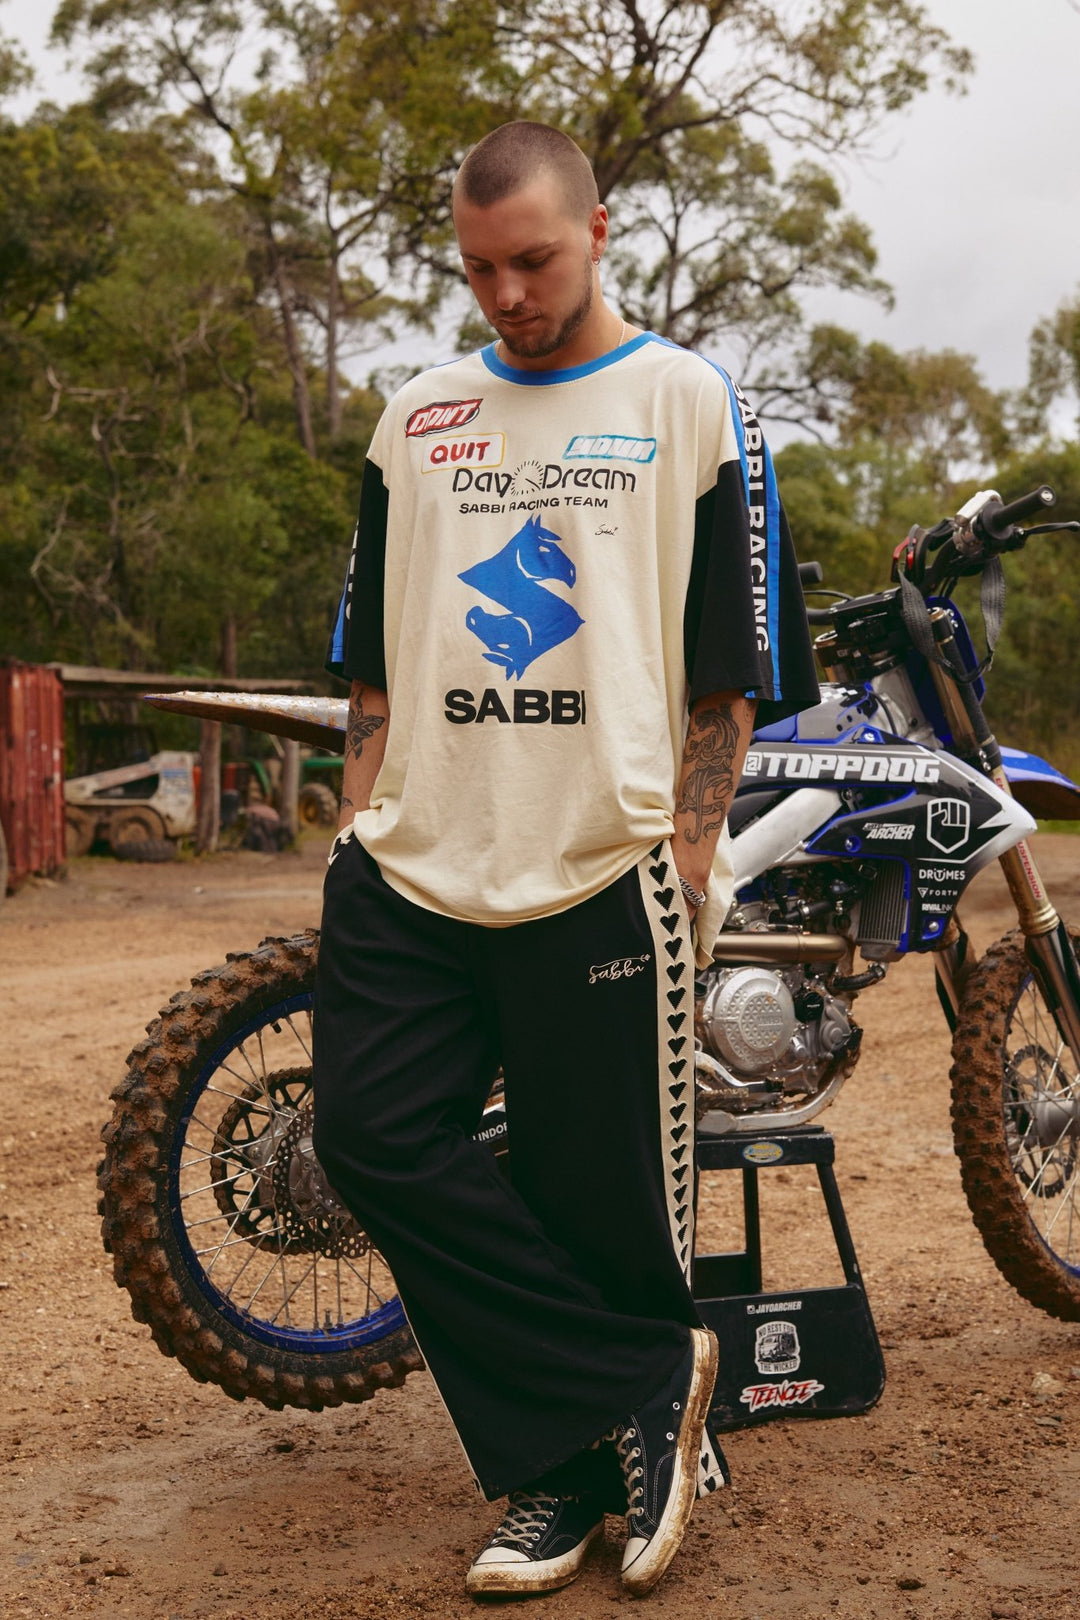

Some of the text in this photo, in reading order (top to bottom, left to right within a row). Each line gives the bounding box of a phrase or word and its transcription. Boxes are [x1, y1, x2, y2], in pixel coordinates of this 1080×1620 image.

[408, 402, 478, 433] DONT
[430, 441, 491, 464] QUIT
[542, 464, 636, 492] Dream
[459, 496, 608, 514] SABBI RACING TEAM
[749, 506, 770, 652] RACING
[444, 688, 586, 725] SABBI
[742, 751, 941, 783] @TOPPDOG
[866, 825, 915, 839] ARCHER
[1017, 841, 1042, 899] USPENSION
[768, 1324, 782, 1333] REST
[760, 1361, 772, 1372] THE
